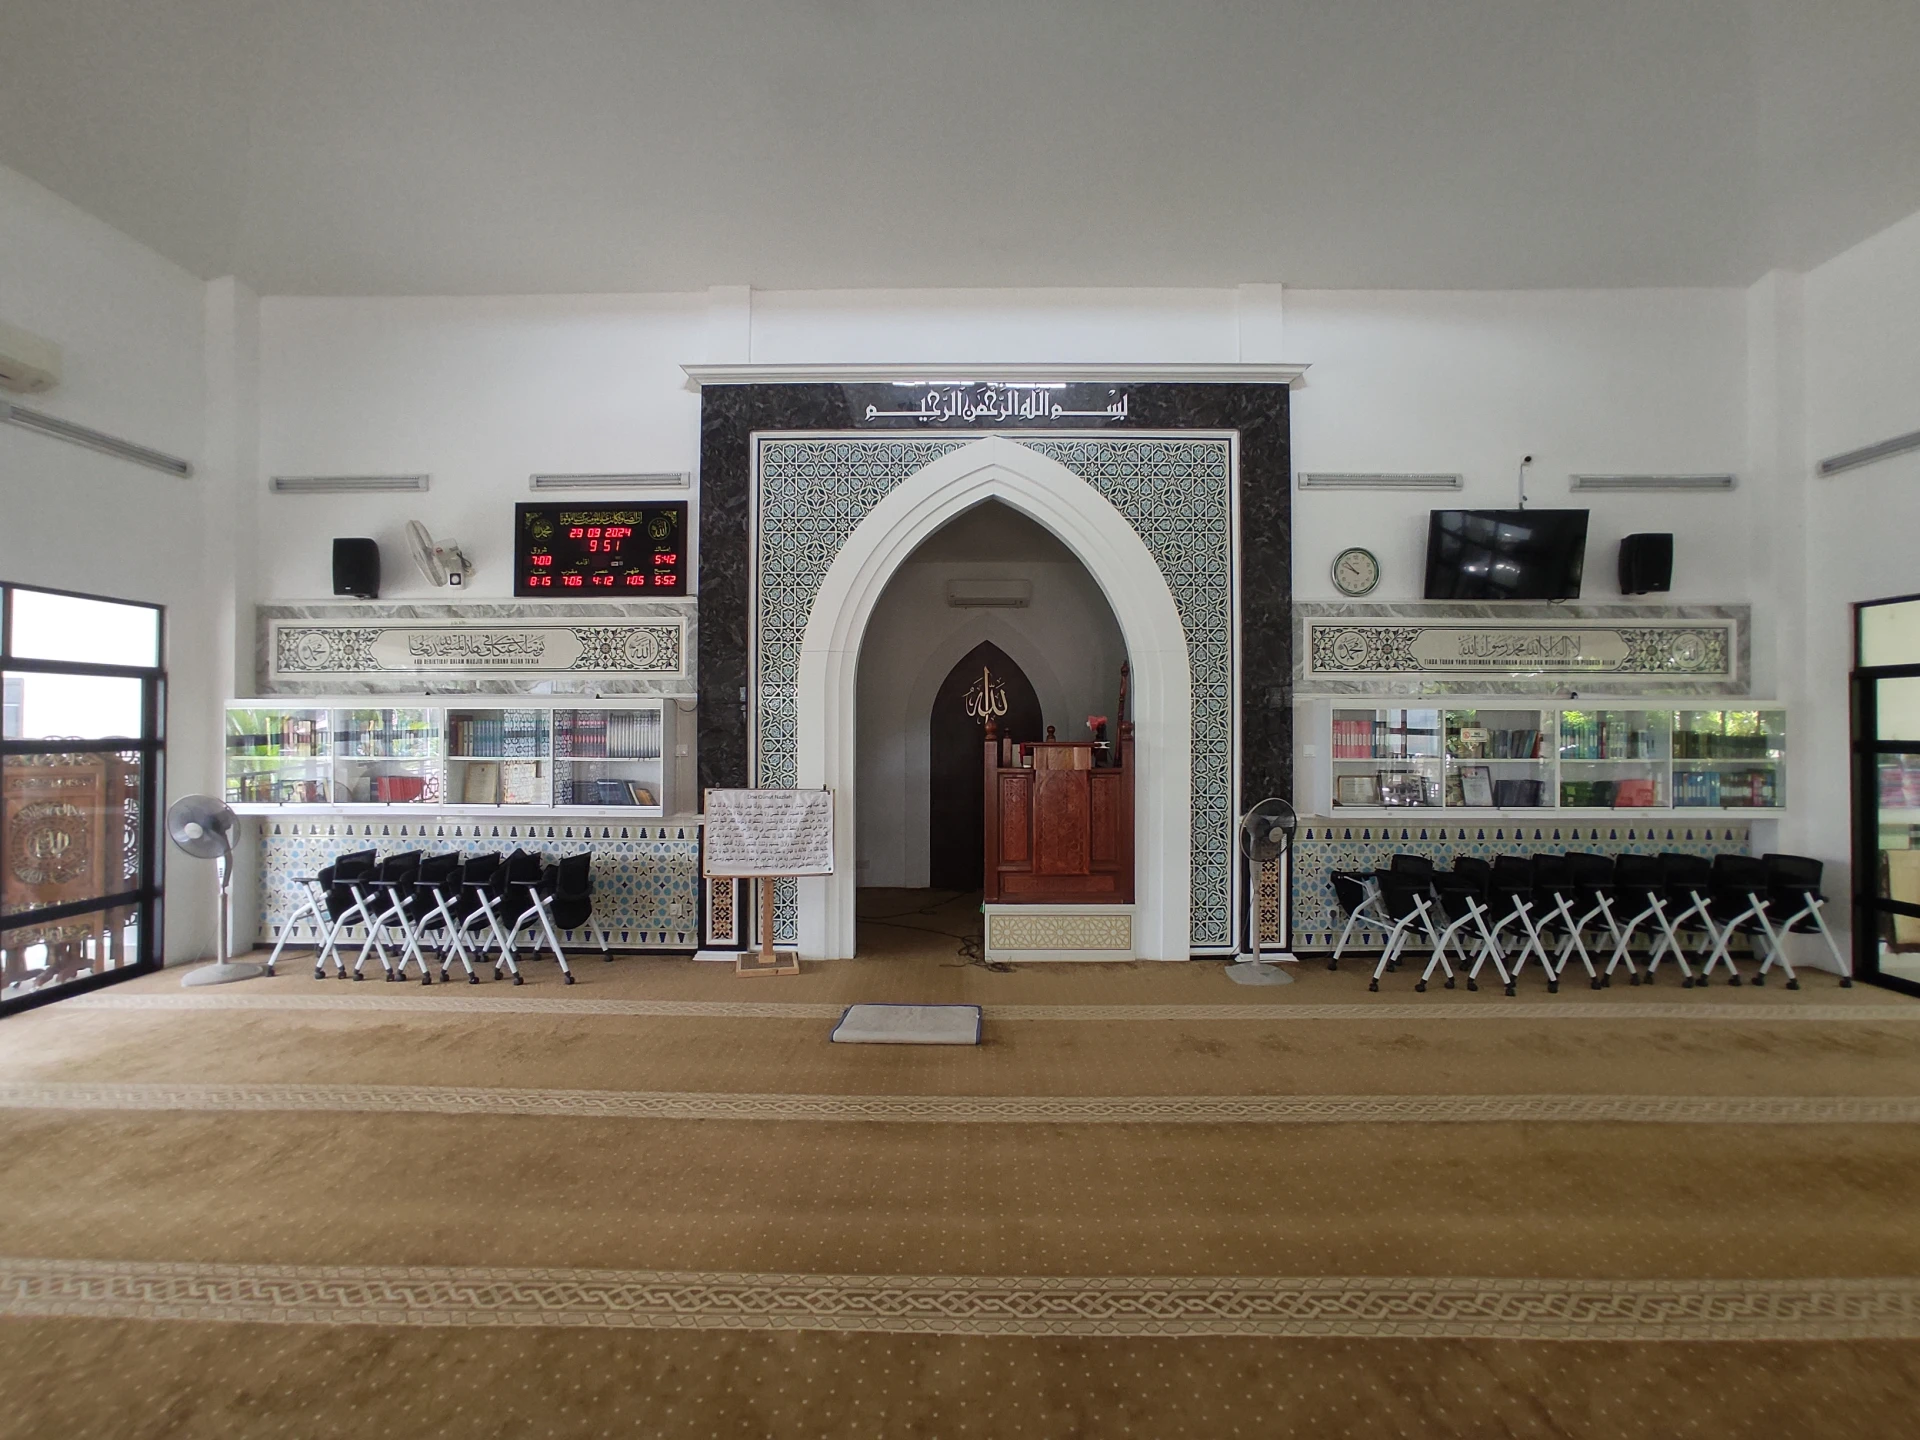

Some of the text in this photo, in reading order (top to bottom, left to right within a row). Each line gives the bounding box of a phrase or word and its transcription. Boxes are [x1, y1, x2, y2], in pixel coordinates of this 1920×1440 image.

[569, 527, 632, 538] 29 09 2024
[531, 555, 552, 566] 7:00
[654, 554, 677, 564] 5:42
[529, 576, 552, 586] 8:15
[592, 576, 614, 586] 4:12
[654, 575, 677, 585] 5:52
